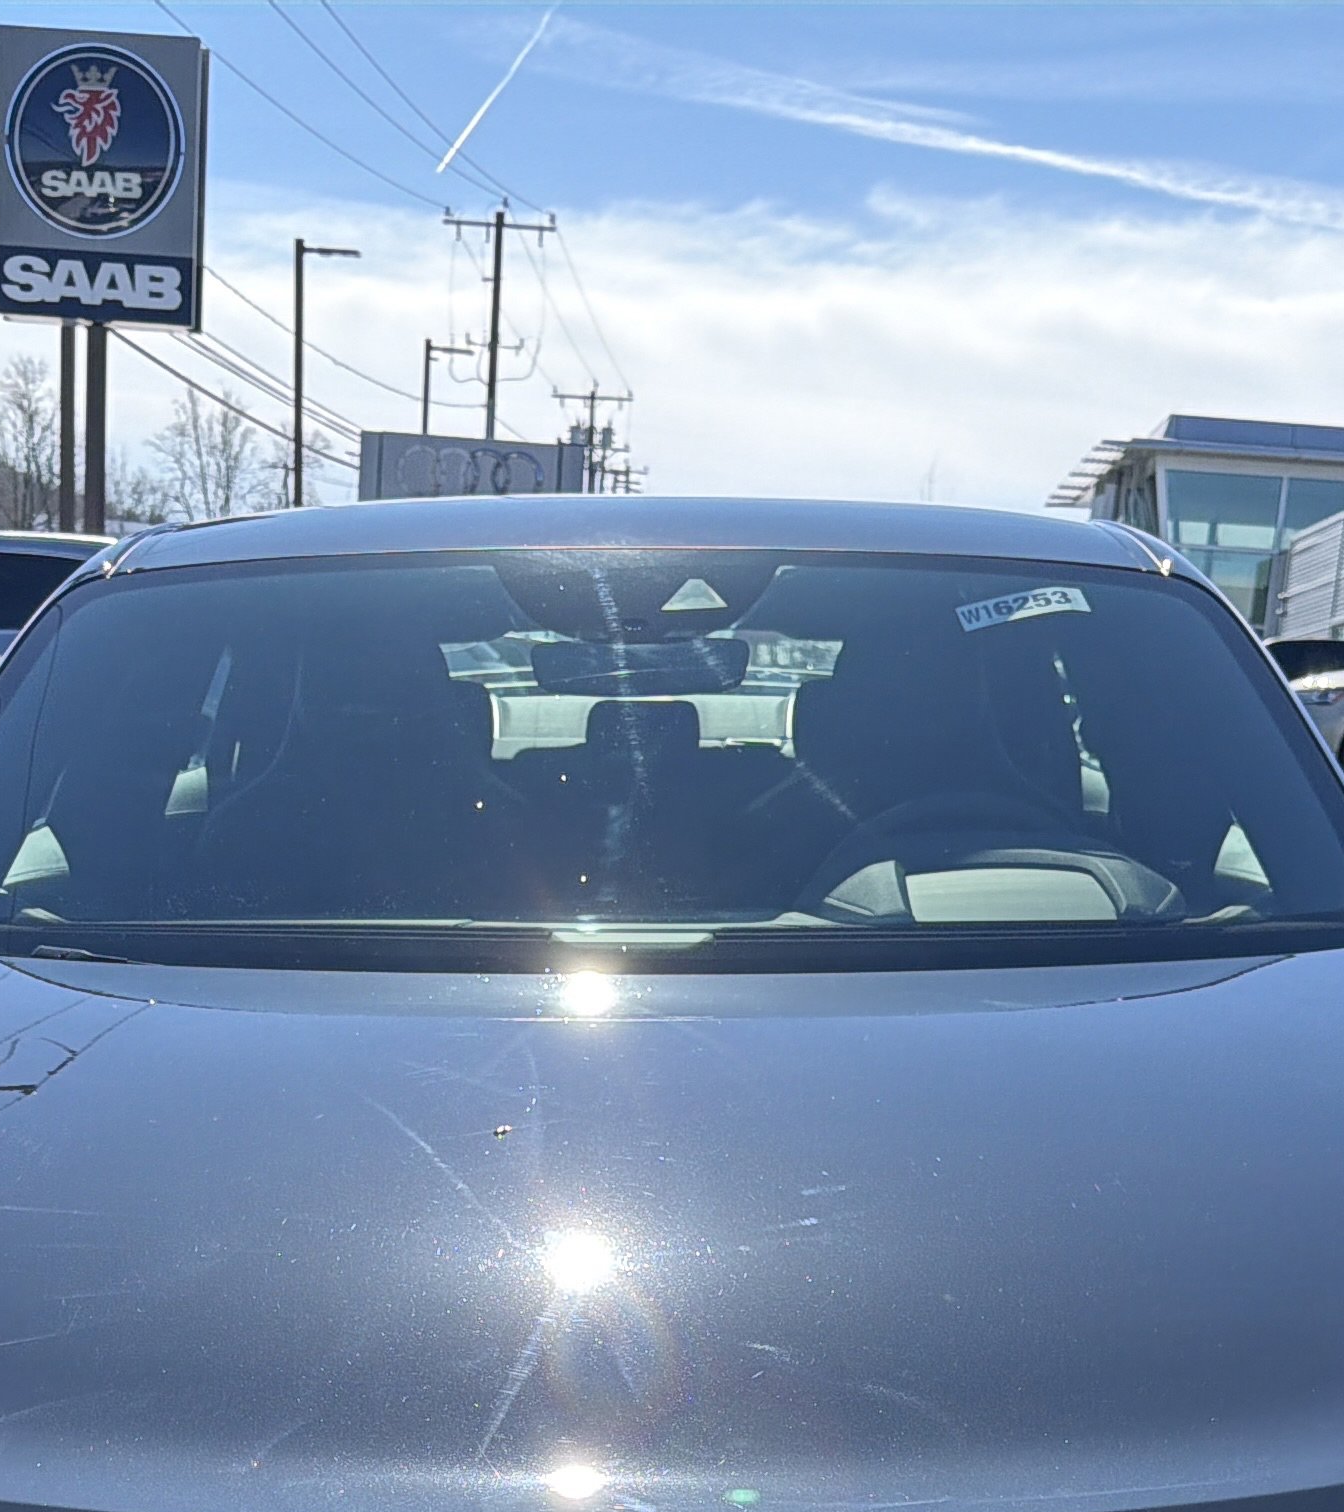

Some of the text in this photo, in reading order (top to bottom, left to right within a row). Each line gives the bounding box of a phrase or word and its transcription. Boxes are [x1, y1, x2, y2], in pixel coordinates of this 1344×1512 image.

[41, 169, 143, 199] SAAB
[0, 255, 183, 311] SAAB
[960, 590, 1073, 625] W16253
